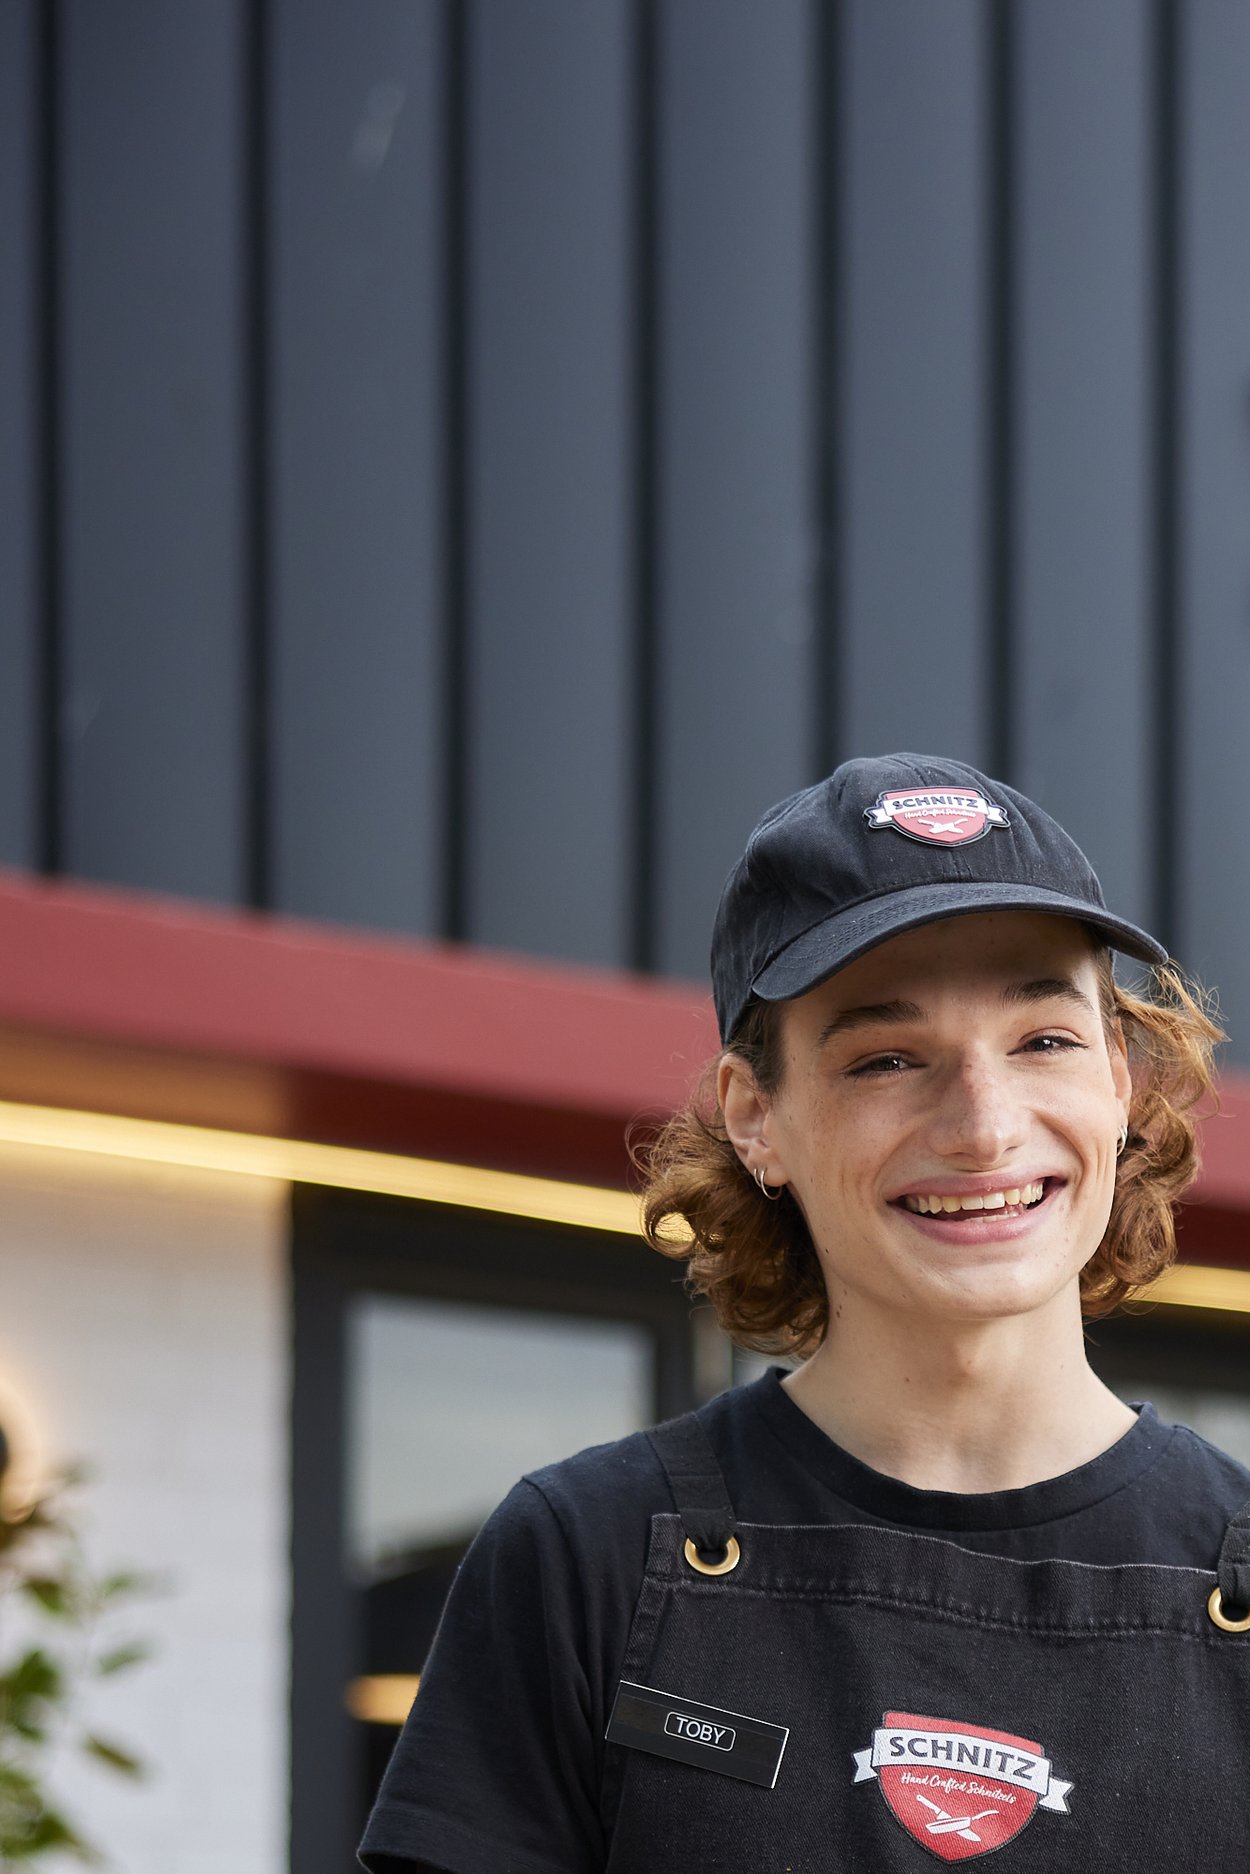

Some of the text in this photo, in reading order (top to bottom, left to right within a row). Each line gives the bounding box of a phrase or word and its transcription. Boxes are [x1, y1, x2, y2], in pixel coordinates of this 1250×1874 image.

[892, 796, 978, 810] SCHNITZ
[676, 1716, 726, 1745] TOBY
[889, 1736, 1037, 1780] SCHNITZ
[901, 1772, 1017, 1804] Hand Crafted Schnitzels
